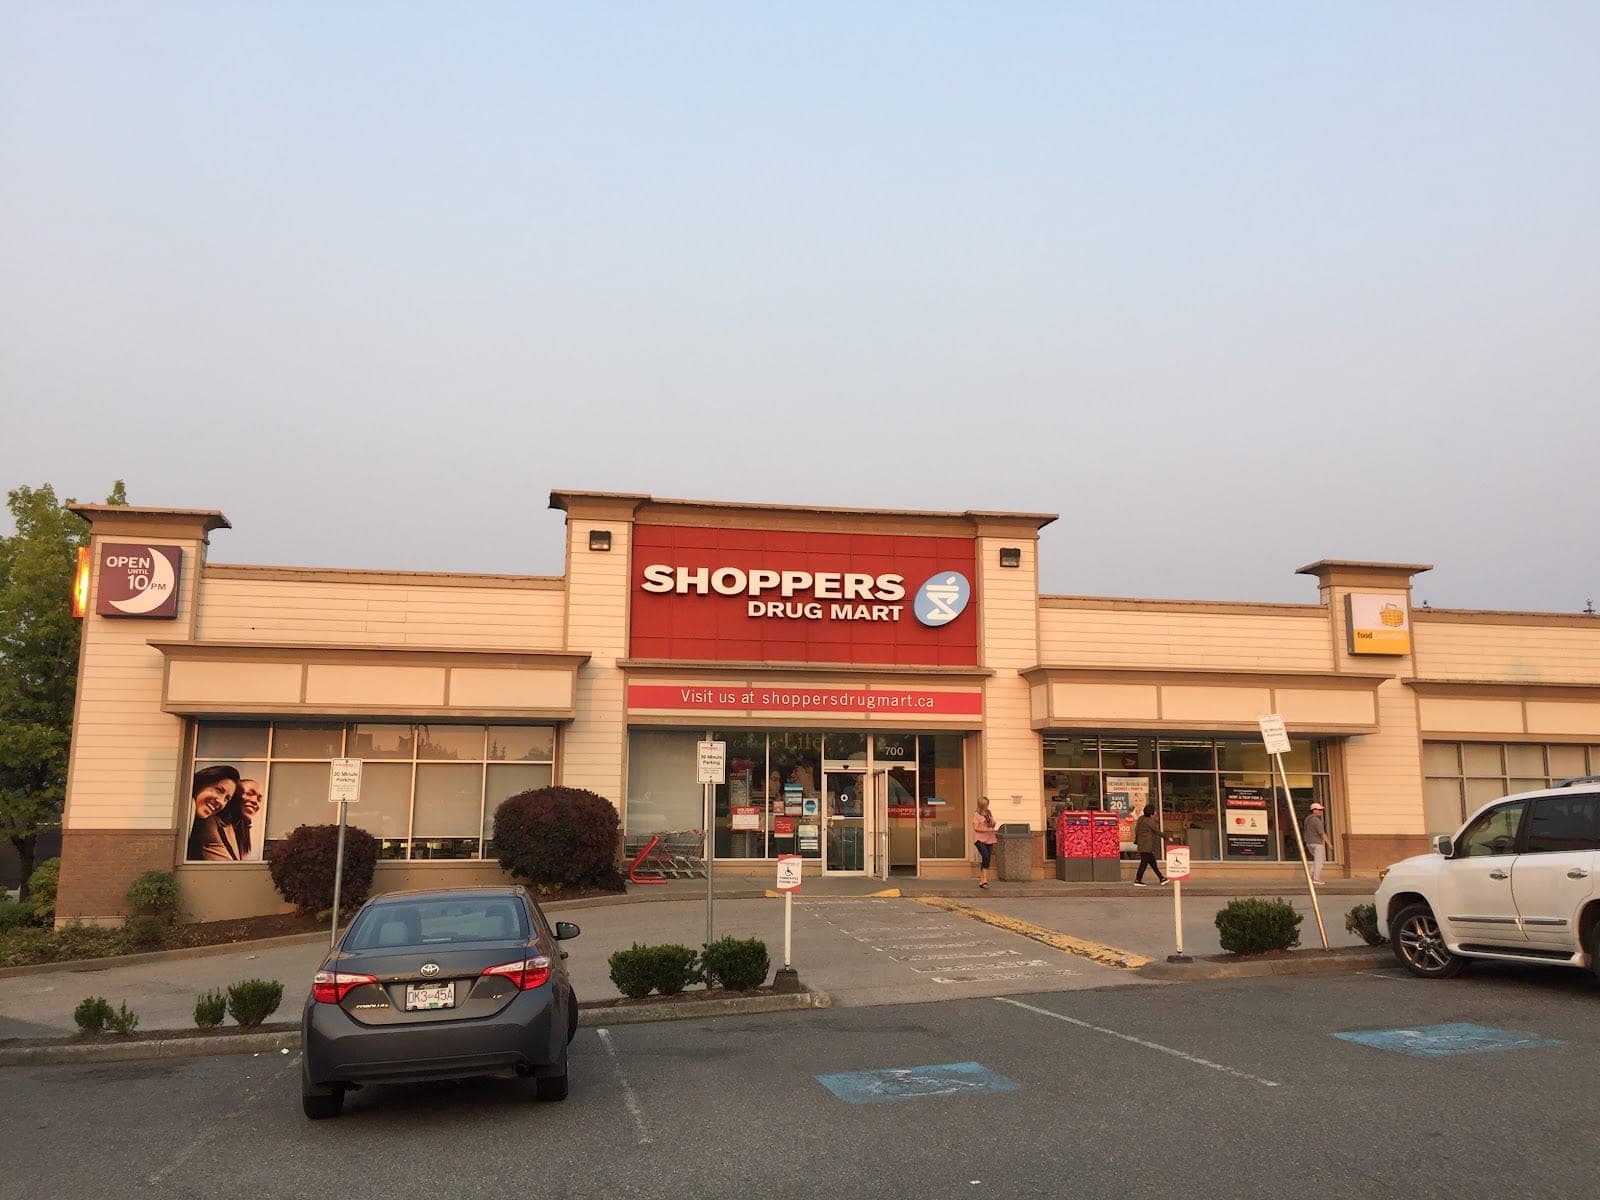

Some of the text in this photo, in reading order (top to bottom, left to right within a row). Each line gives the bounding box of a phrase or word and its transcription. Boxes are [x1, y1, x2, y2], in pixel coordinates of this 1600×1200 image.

[106, 556, 150, 569] OPEN
[128, 575, 149, 591] 10
[641, 564, 905, 601] SHOPPERS
[748, 600, 904, 622] DRUG MART
[681, 689, 934, 709] Visit us at shoppersdrugmart.ca
[885, 746, 904, 756] 700
